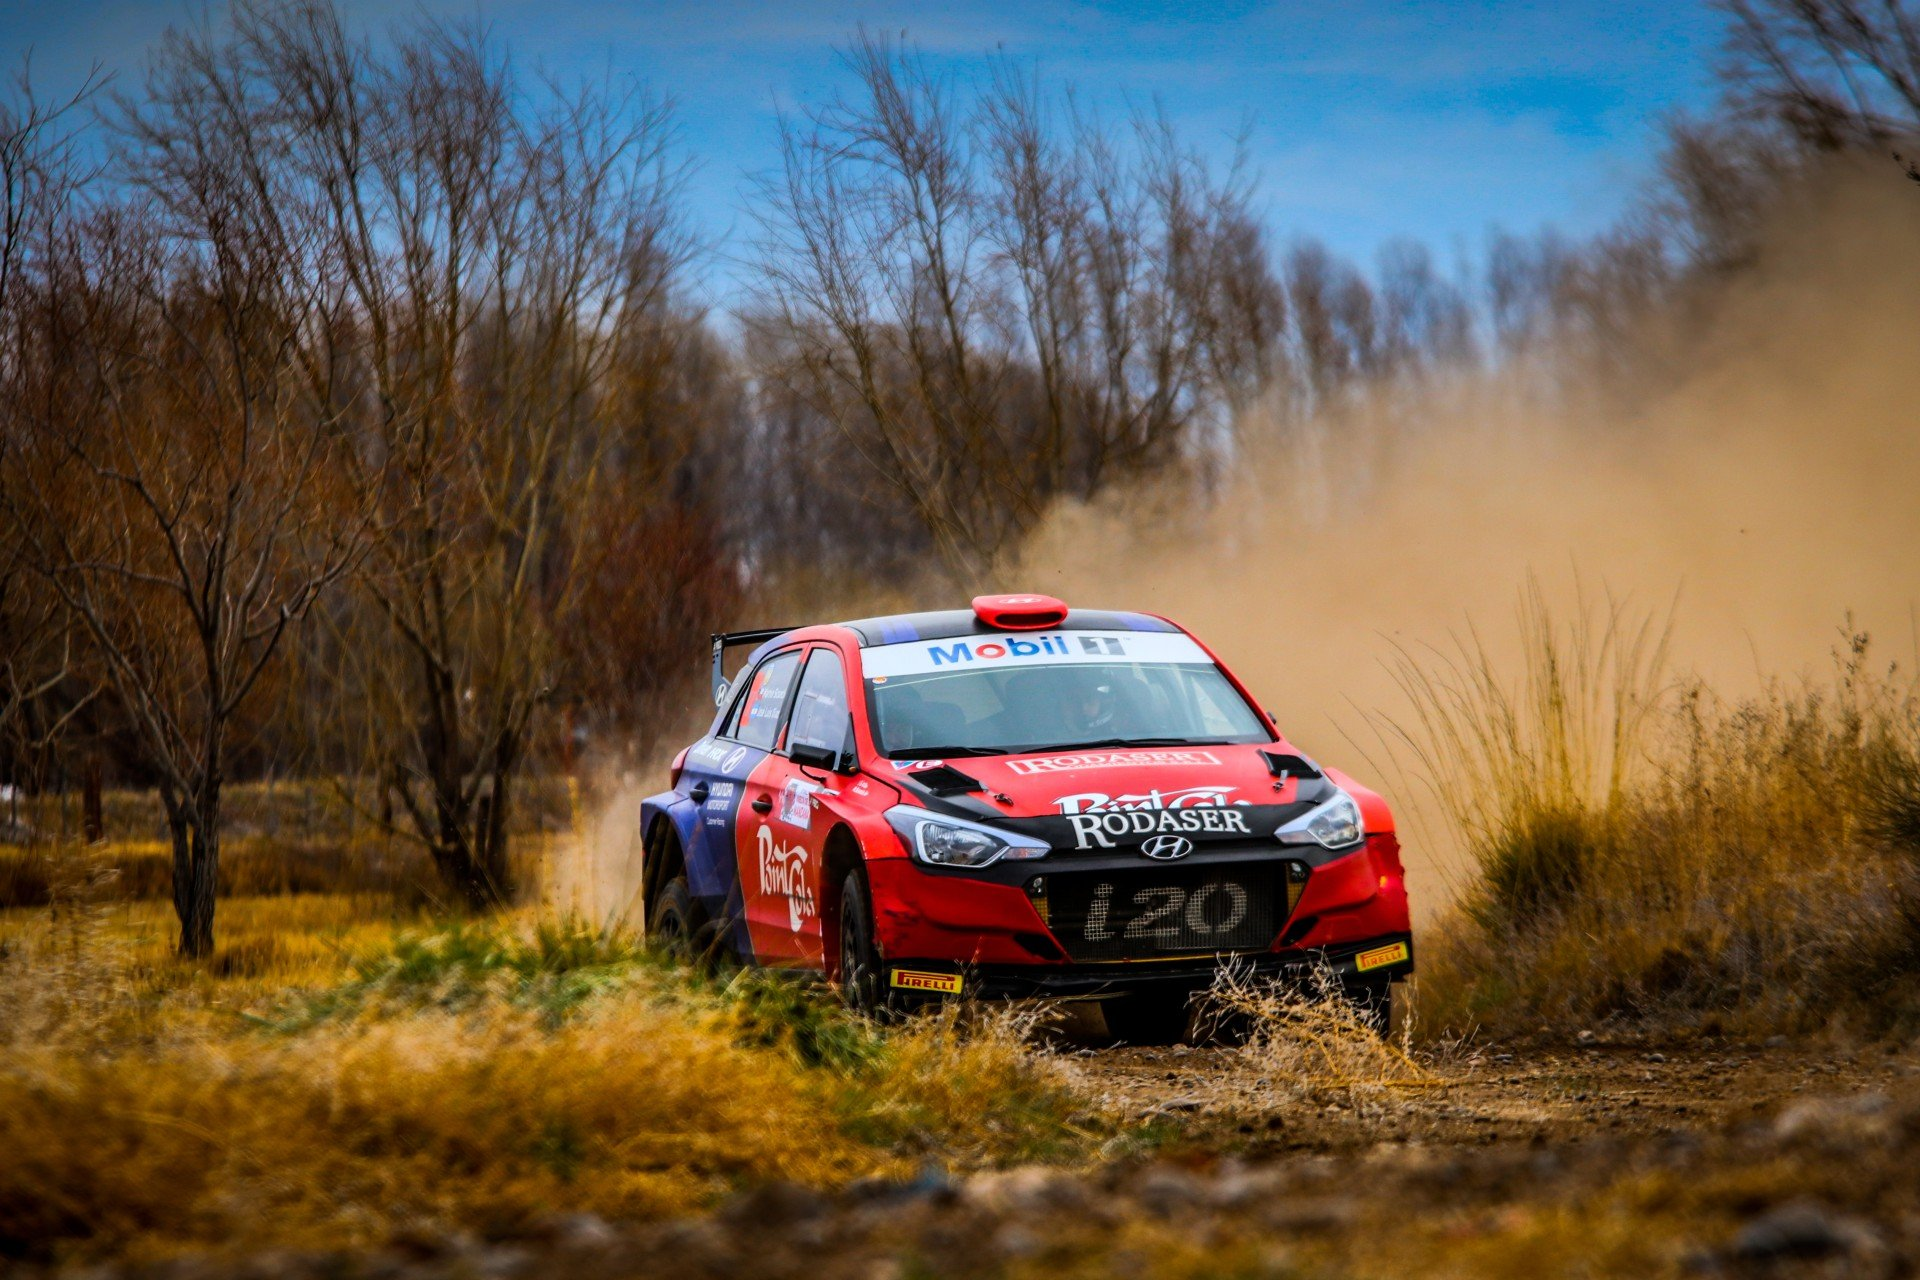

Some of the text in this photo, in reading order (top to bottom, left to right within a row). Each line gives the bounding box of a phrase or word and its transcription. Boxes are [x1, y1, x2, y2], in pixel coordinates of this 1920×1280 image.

[927, 635, 1069, 666] Mobil
[1020, 750, 1200, 775] RODASER
[709, 782, 734, 797] HYUNDAI
[1066, 808, 1251, 850] RODASER
[757, 825, 808, 895] Point
[1360, 945, 1401, 968] PIRELLI
[897, 972, 955, 990] PIRELLI
